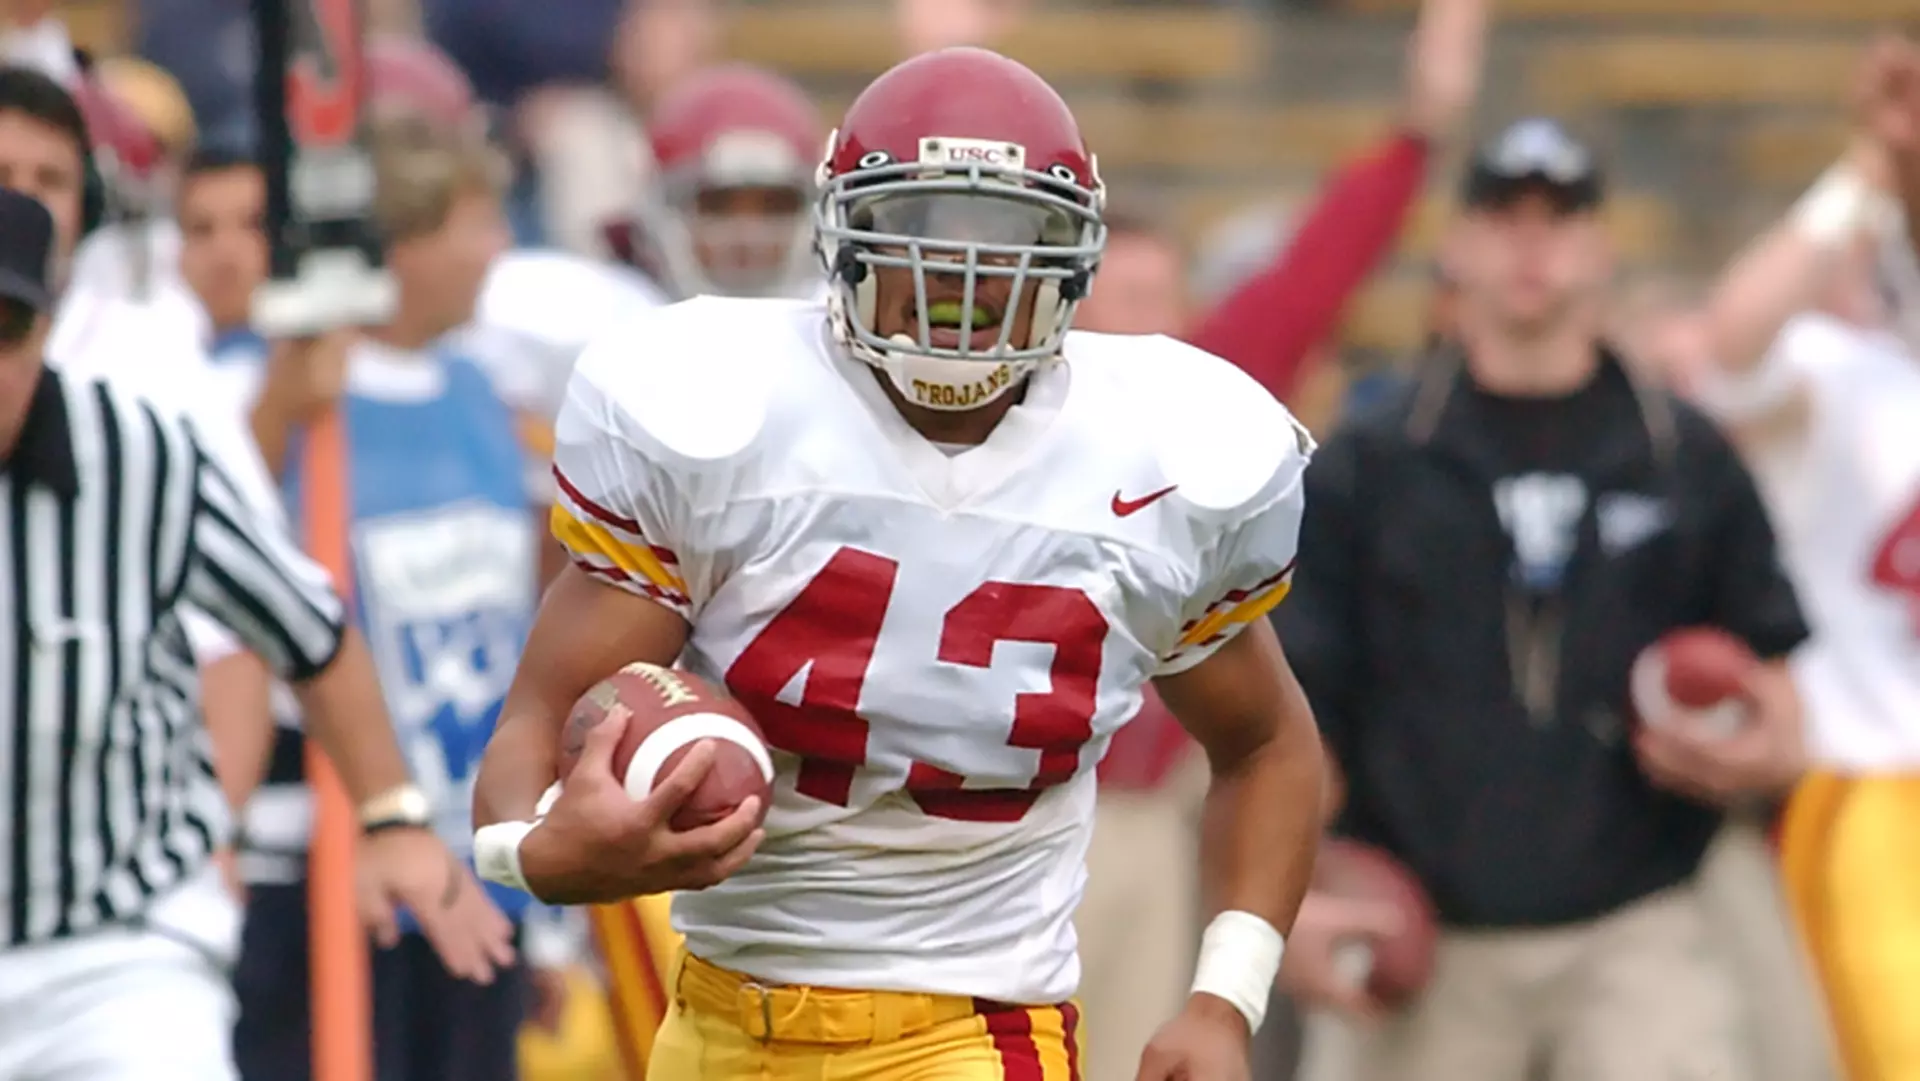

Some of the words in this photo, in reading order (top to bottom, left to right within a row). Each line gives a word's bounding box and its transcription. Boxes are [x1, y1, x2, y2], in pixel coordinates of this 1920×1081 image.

[949, 147, 1002, 163] USC
[912, 363, 1010, 406] TROJANS
[725, 546, 1109, 823] 43
